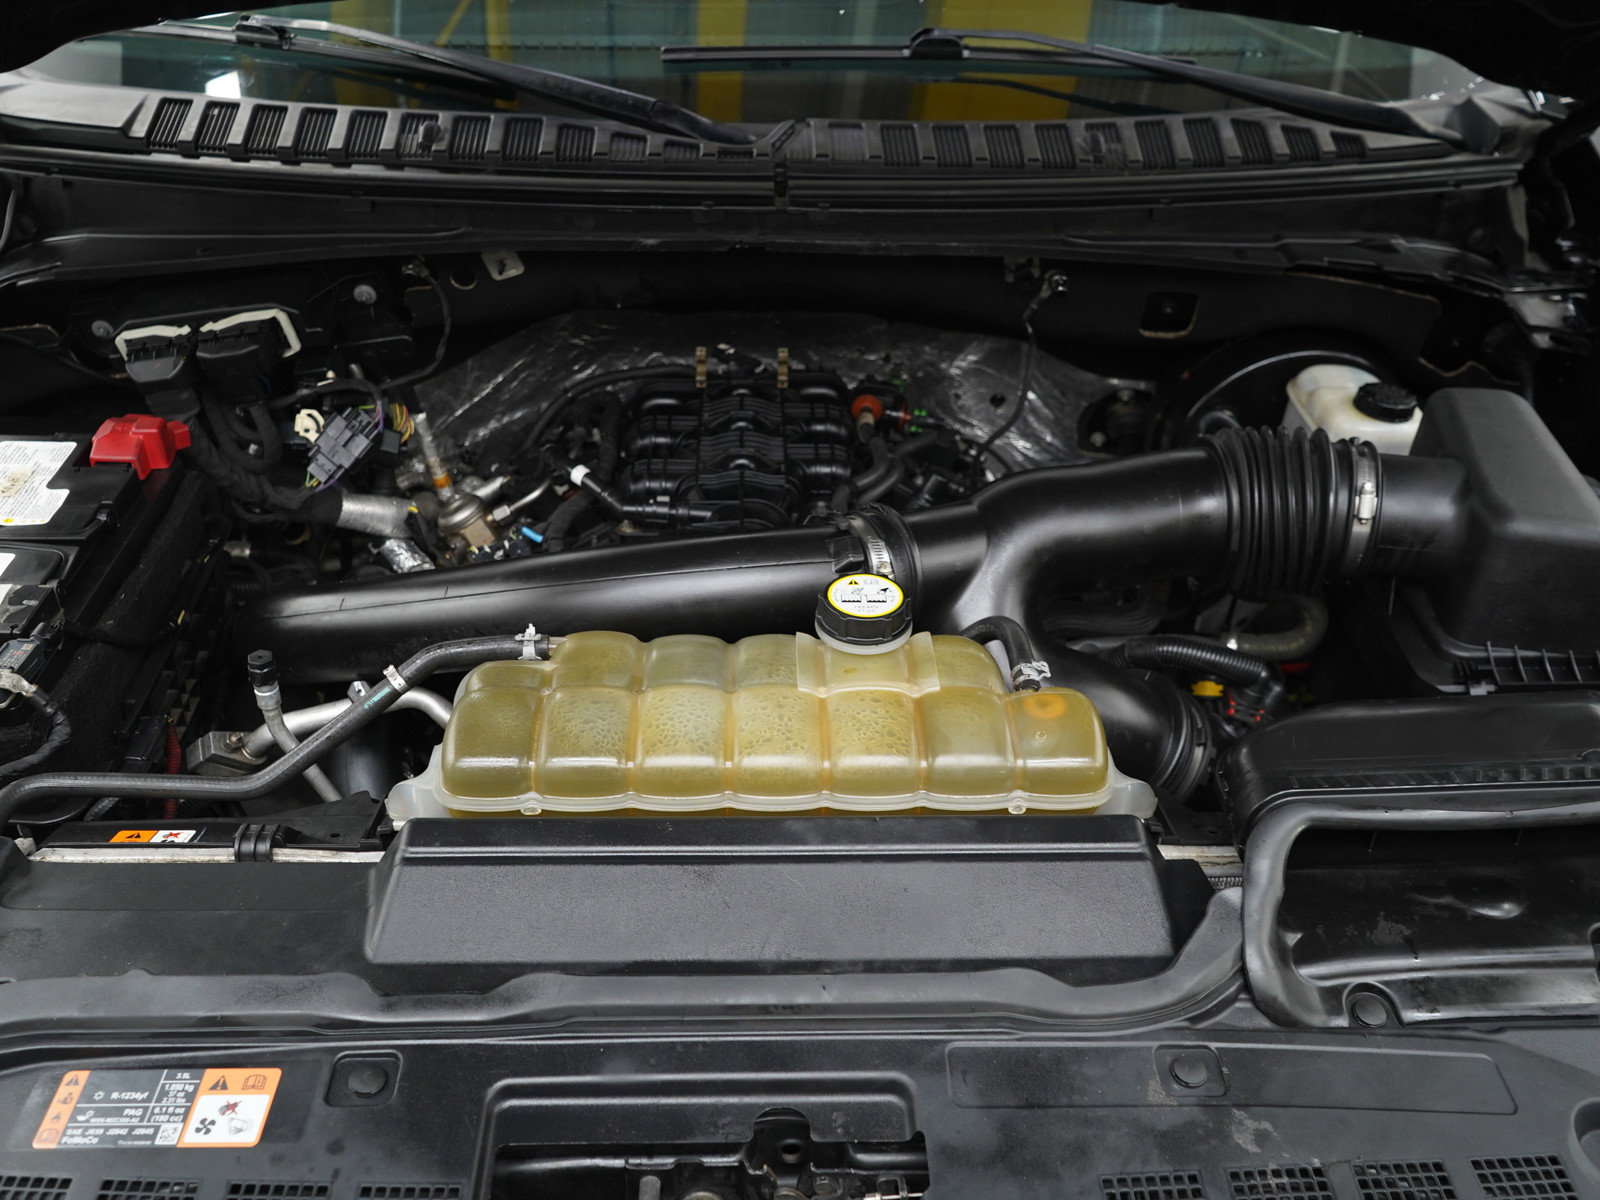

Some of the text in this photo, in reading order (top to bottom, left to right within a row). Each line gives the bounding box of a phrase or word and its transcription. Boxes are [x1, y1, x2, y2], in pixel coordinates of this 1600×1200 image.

[110, 1091, 150, 1101] R-1234yf
[122, 1108, 144, 1117] PAG
[60, 1136, 100, 1145] FoMoCo
